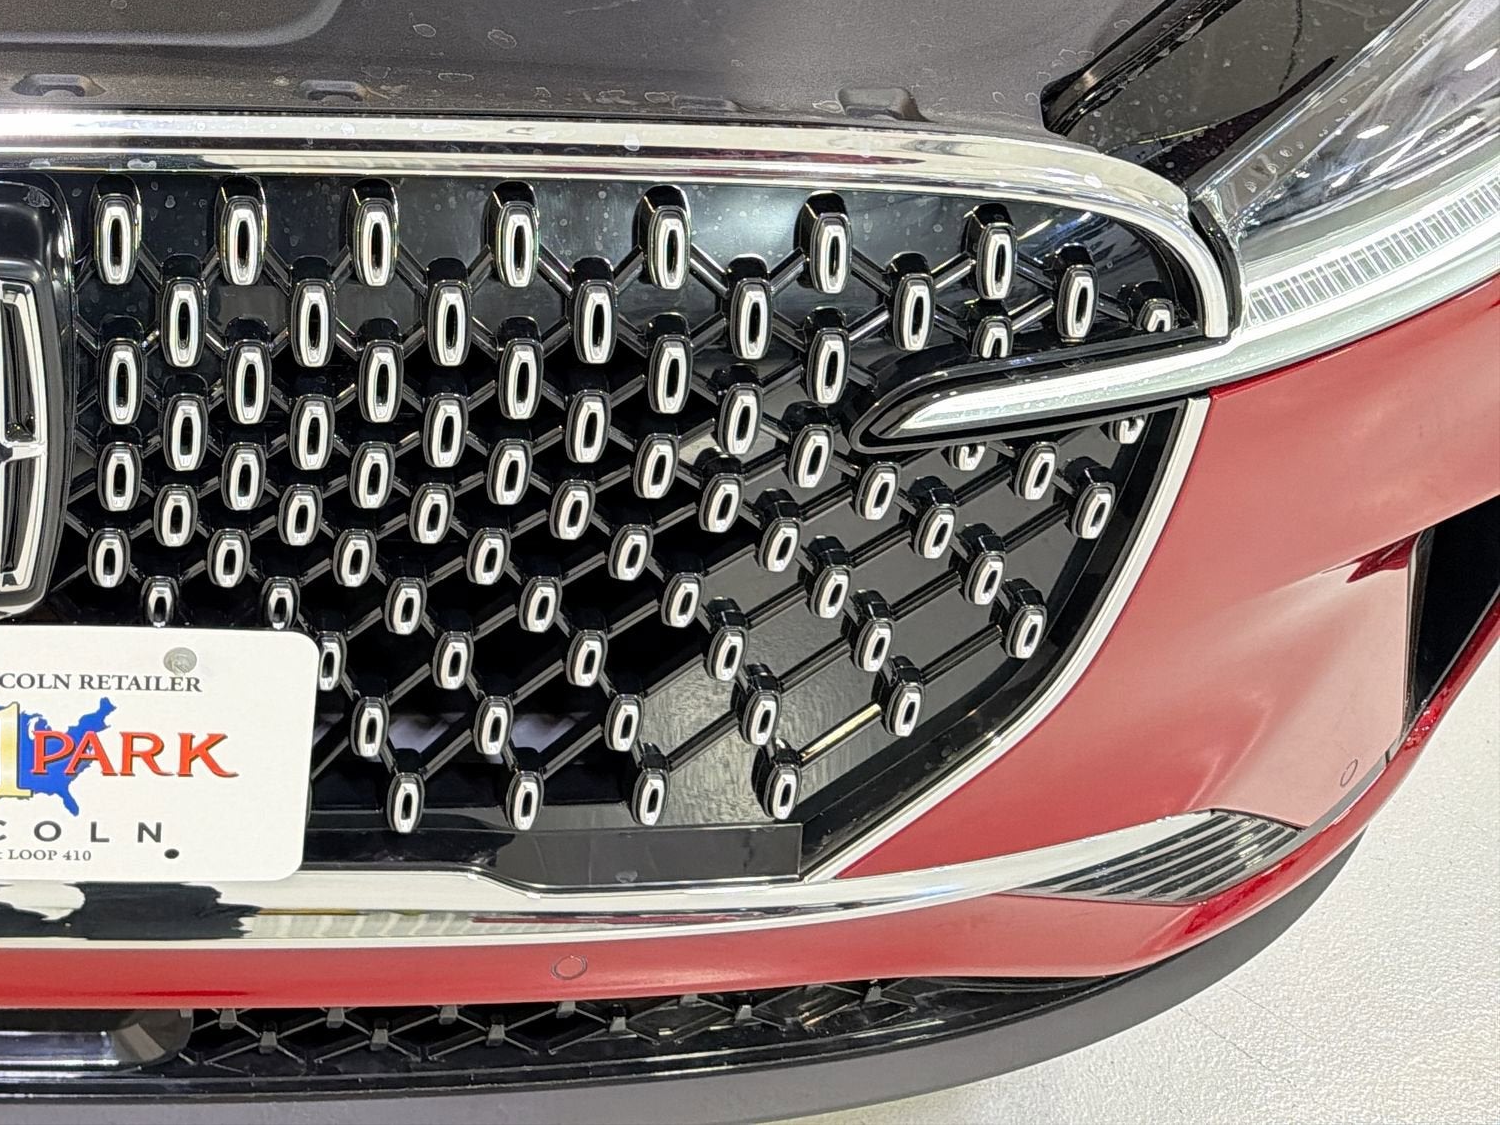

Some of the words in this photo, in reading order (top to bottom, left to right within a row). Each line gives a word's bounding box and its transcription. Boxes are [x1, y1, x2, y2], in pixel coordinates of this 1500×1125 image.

[78, 674, 203, 693] RETAILER
[31, 730, 240, 778] PARK
[7, 849, 59, 862] LOOP
[62, 849, 93, 862] 410
